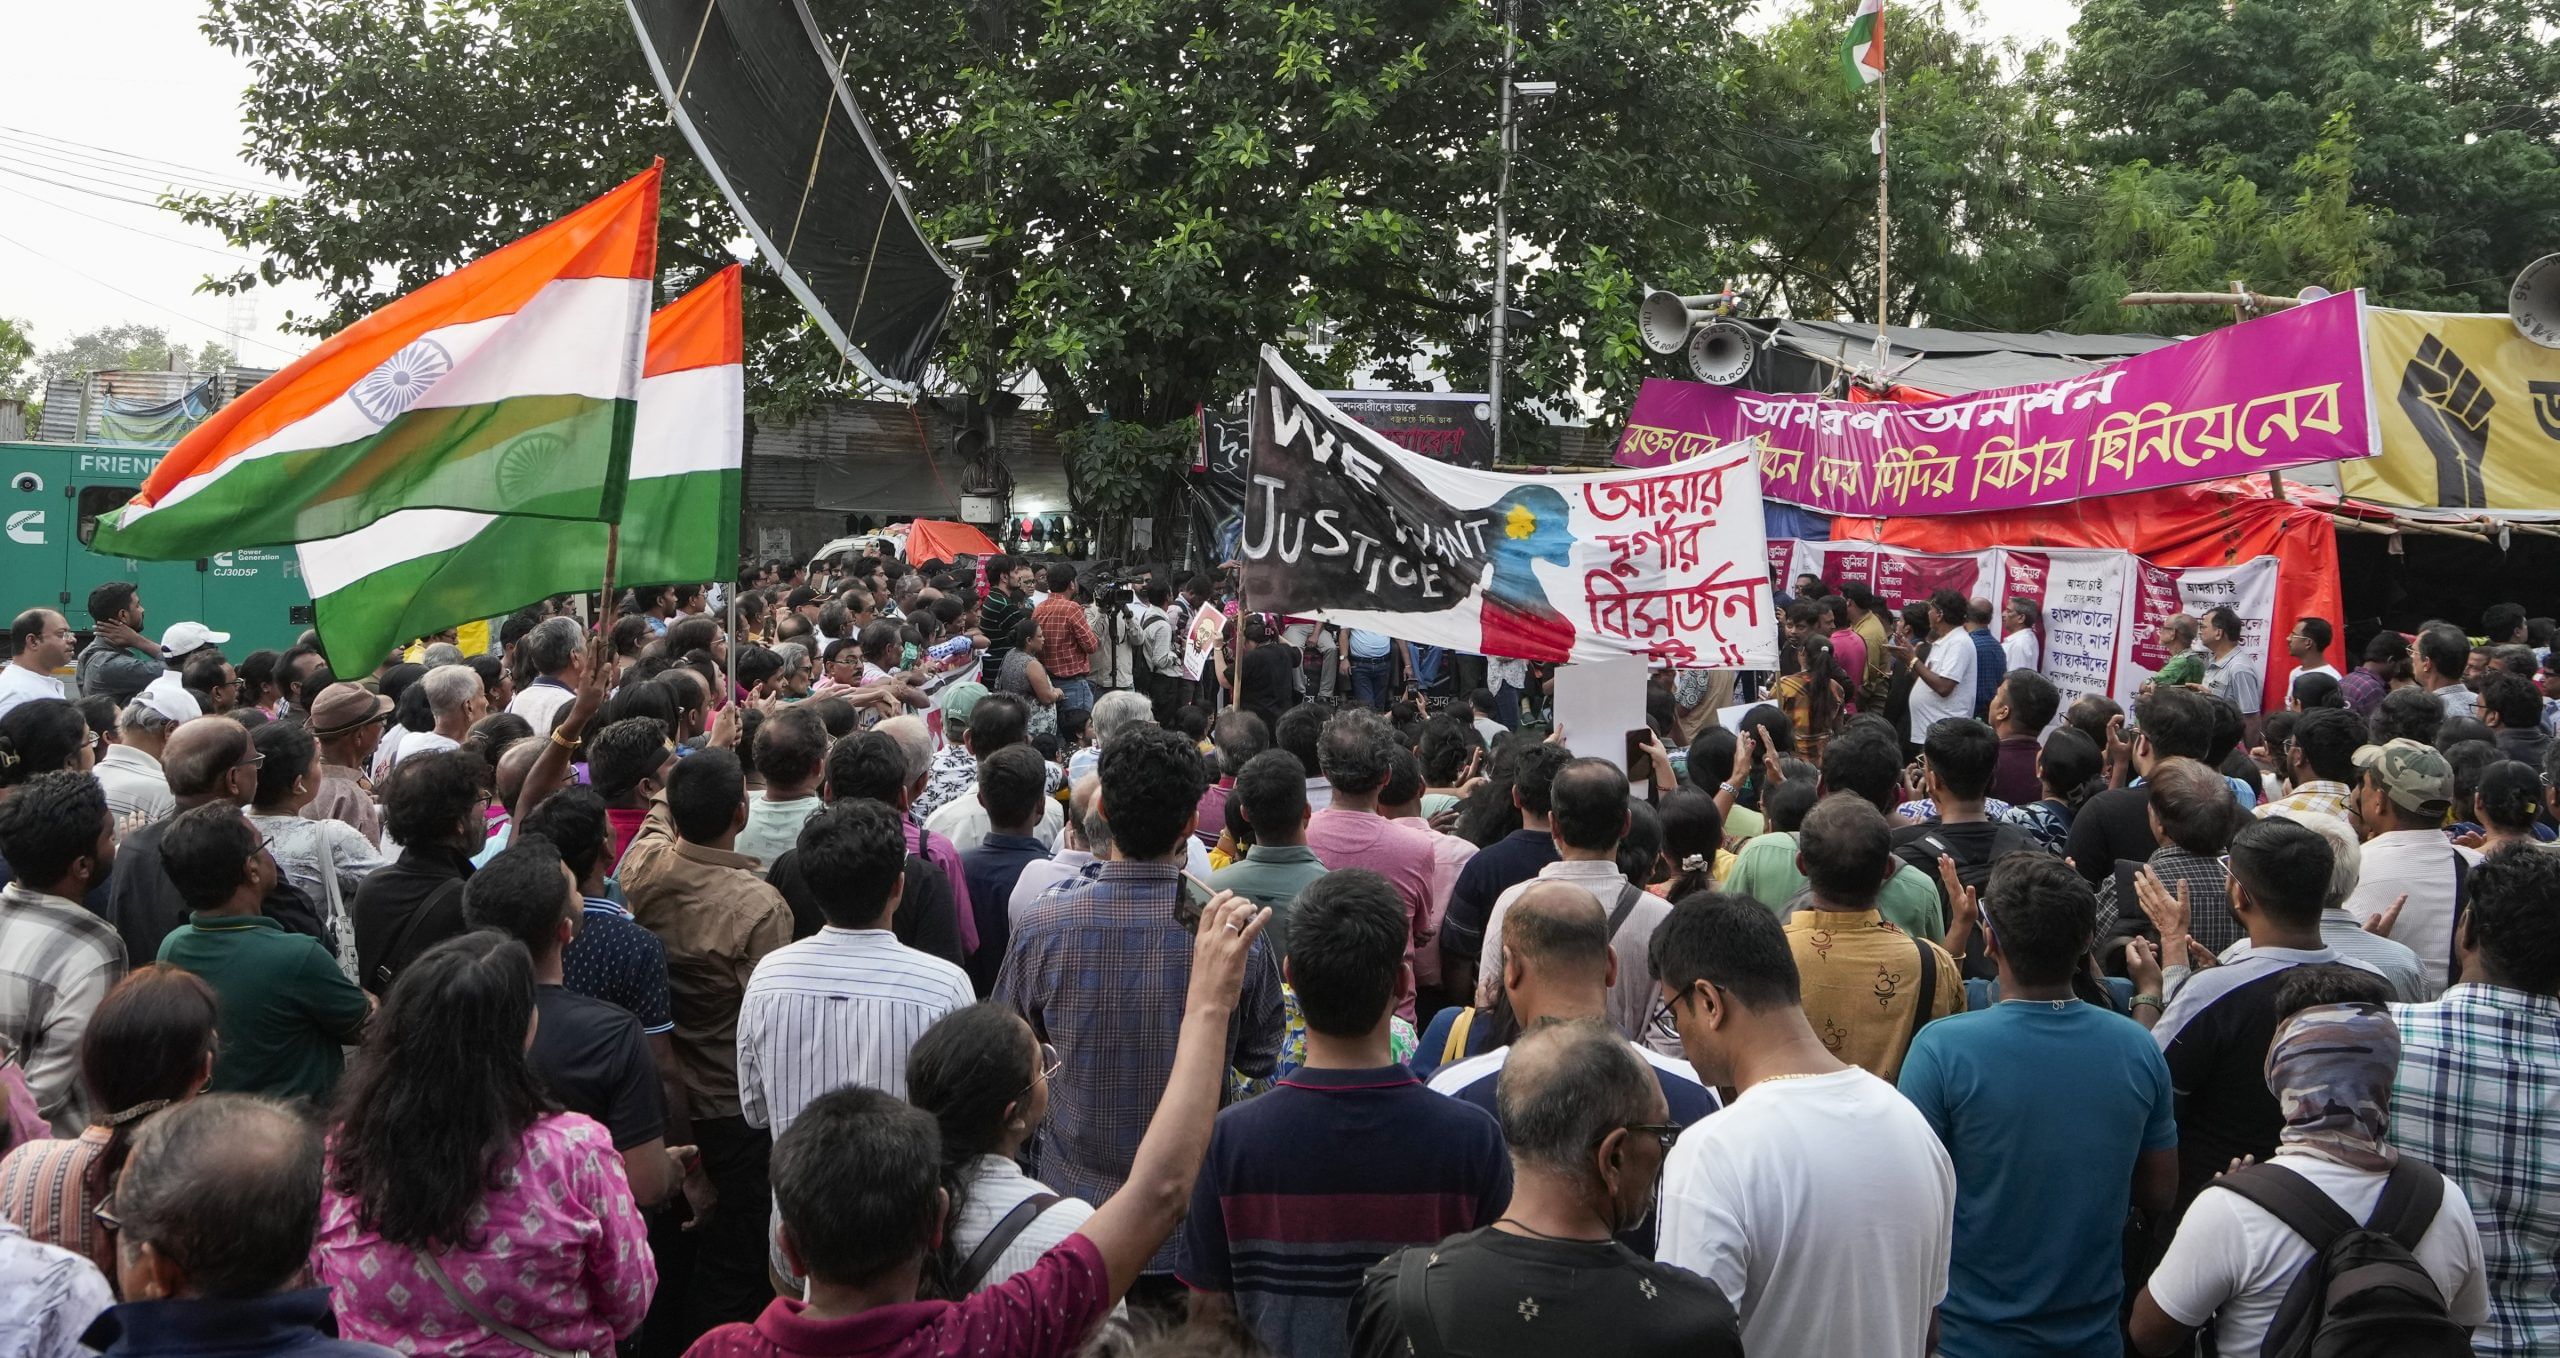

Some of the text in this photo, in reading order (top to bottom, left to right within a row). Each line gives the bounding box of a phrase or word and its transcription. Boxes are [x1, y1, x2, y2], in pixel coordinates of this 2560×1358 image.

[1333, 400, 1392, 412] নশনকারীদের
[1735, 371, 2127, 438] আমরণ অনশন
[1270, 386, 1384, 496] WE
[1386, 506, 1489, 568] WANT
[1754, 430, 1805, 485] ীবন
[1810, 455, 1862, 497] দেব
[1871, 445, 1961, 507] দিদির
[1970, 435, 2076, 501] বিচার
[1584, 456, 1749, 521] আমার
[6, 510, 41, 531] Cummins
[1241, 474, 1444, 598] JUSTICE
[213, 568, 258, 577] CJ30D5P
[2088, 577, 2103, 591] চাই
[2186, 579, 2237, 595] আমরা চাই
[1585, 561, 1769, 643] বিসর্জন
[2051, 607, 2113, 629] হাসপাতালে
[2089, 631, 2111, 650] নার্স
